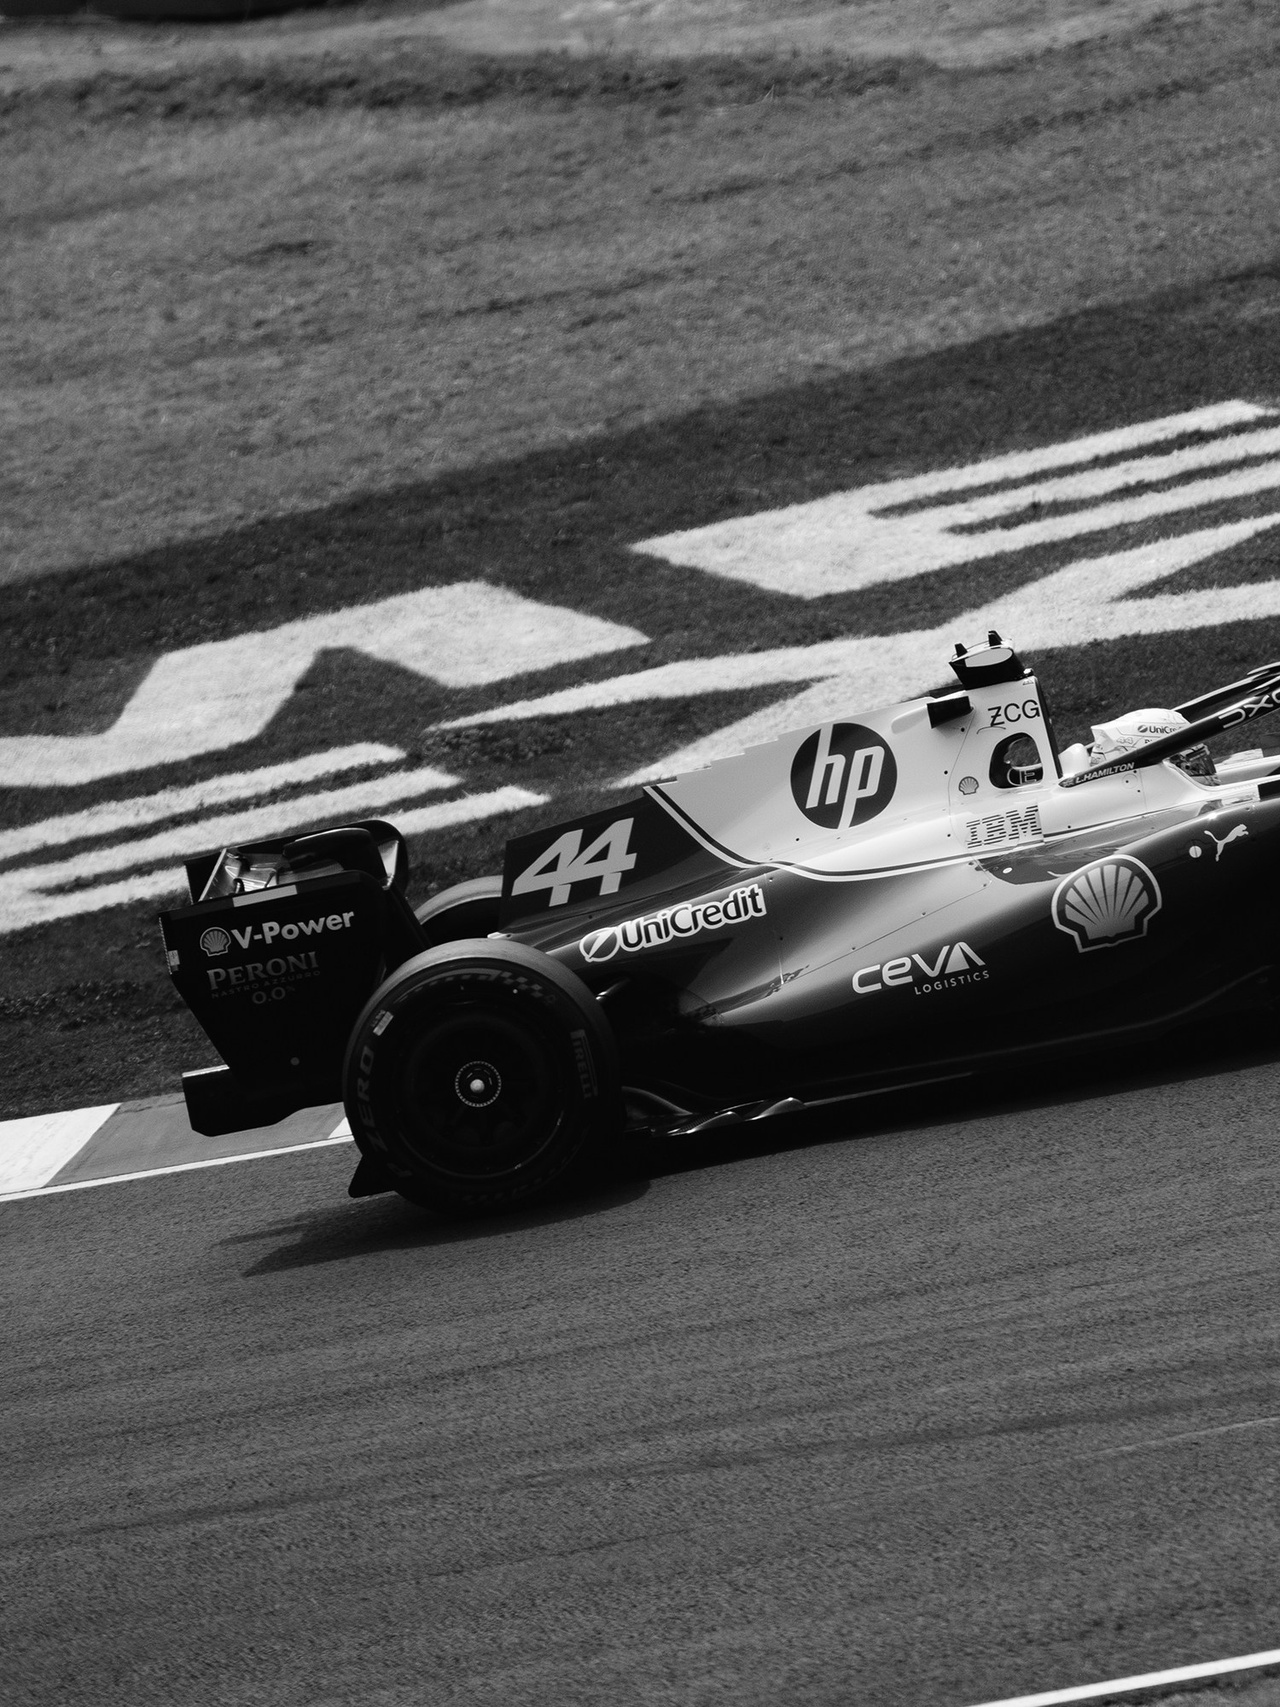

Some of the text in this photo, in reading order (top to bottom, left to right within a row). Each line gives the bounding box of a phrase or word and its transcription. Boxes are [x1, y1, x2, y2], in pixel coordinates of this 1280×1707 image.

[988, 699, 1040, 727] ZCG
[1149, 725, 1182, 734] UniCre
[805, 723, 886, 829] hp
[1076, 762, 1135, 783] L.HAMILTON
[966, 805, 1043, 848] IBM
[511, 817, 638, 907] 44
[230, 910, 355, 949] V-Power
[619, 885, 766, 950] UniCredit
[206, 951, 319, 990] PERONI
[211, 970, 321, 999] NASTRO AZZURRO
[914, 969, 990, 995] LOGISTICS
[570, 1028, 598, 1100] PIRELLI
[356, 1045, 389, 1152] ZERO
